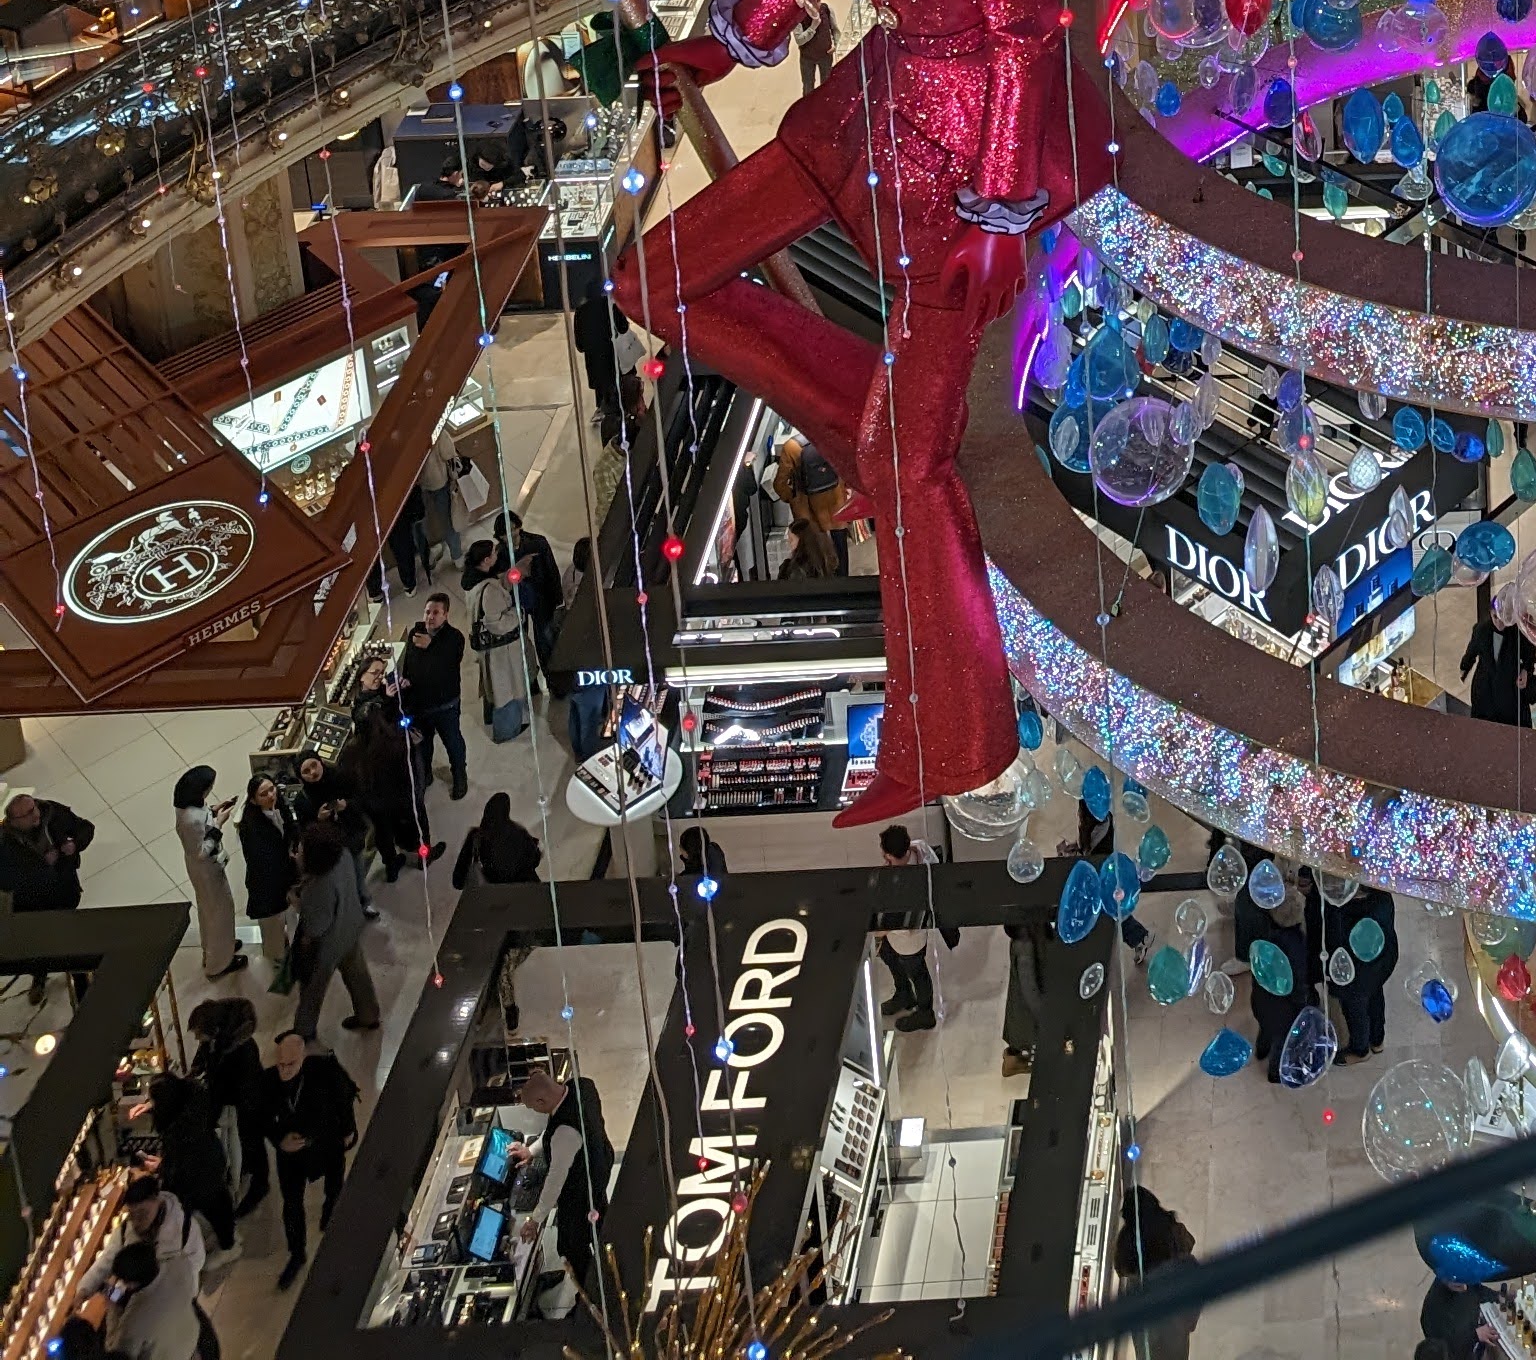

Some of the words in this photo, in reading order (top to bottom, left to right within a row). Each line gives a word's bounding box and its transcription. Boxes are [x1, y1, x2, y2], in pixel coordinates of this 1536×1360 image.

[1164, 524, 1272, 622] DIOR
[187, 599, 262, 648] HERMES
[577, 668, 635, 687] DIOR
[700, 917, 809, 1112] FORD
[645, 1134, 757, 1314] TOM
